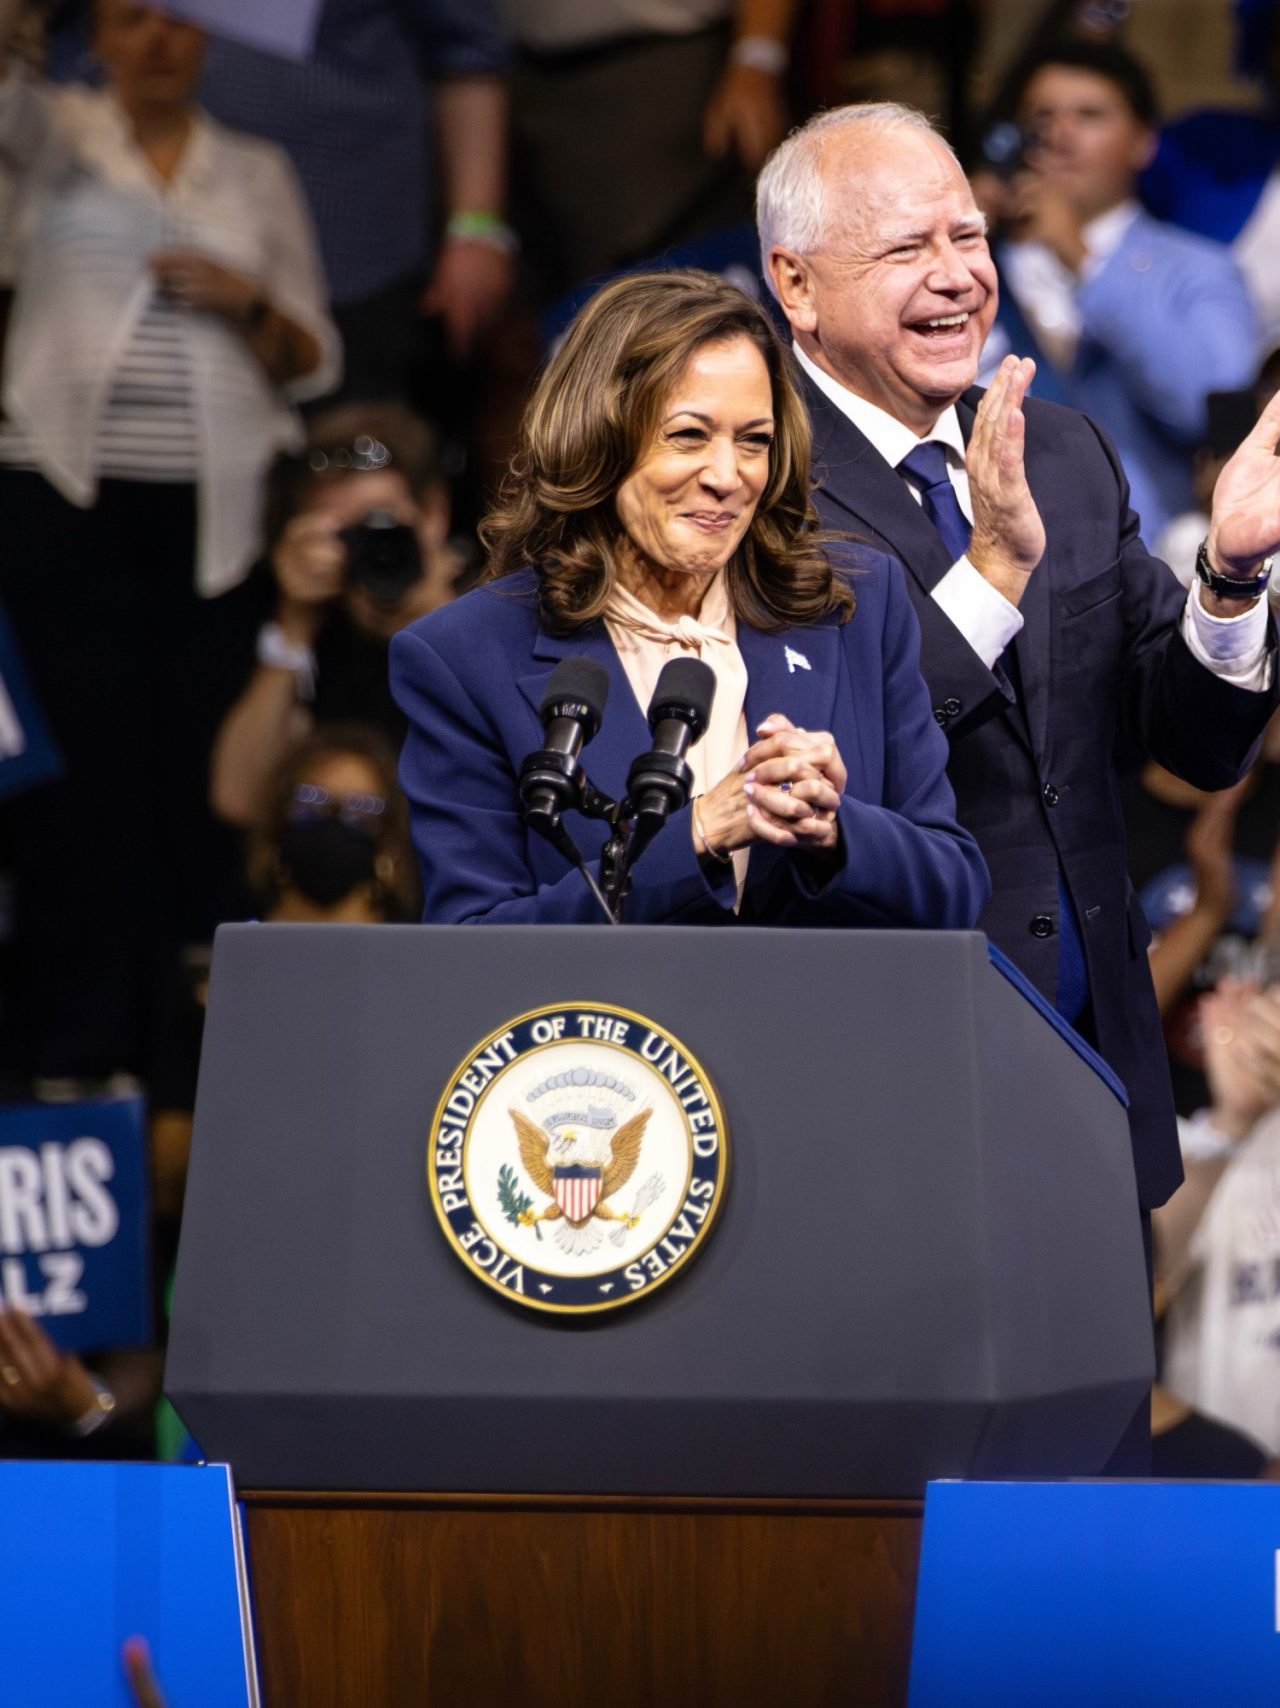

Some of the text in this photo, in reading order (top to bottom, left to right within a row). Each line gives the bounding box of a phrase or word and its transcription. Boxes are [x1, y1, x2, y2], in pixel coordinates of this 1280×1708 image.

[0, 1136, 120, 1255] RIS
[436, 1014, 718, 1294] VICE PRESIDENT OF THE UNITED STATES
[0, 1252, 88, 1317] LZ
